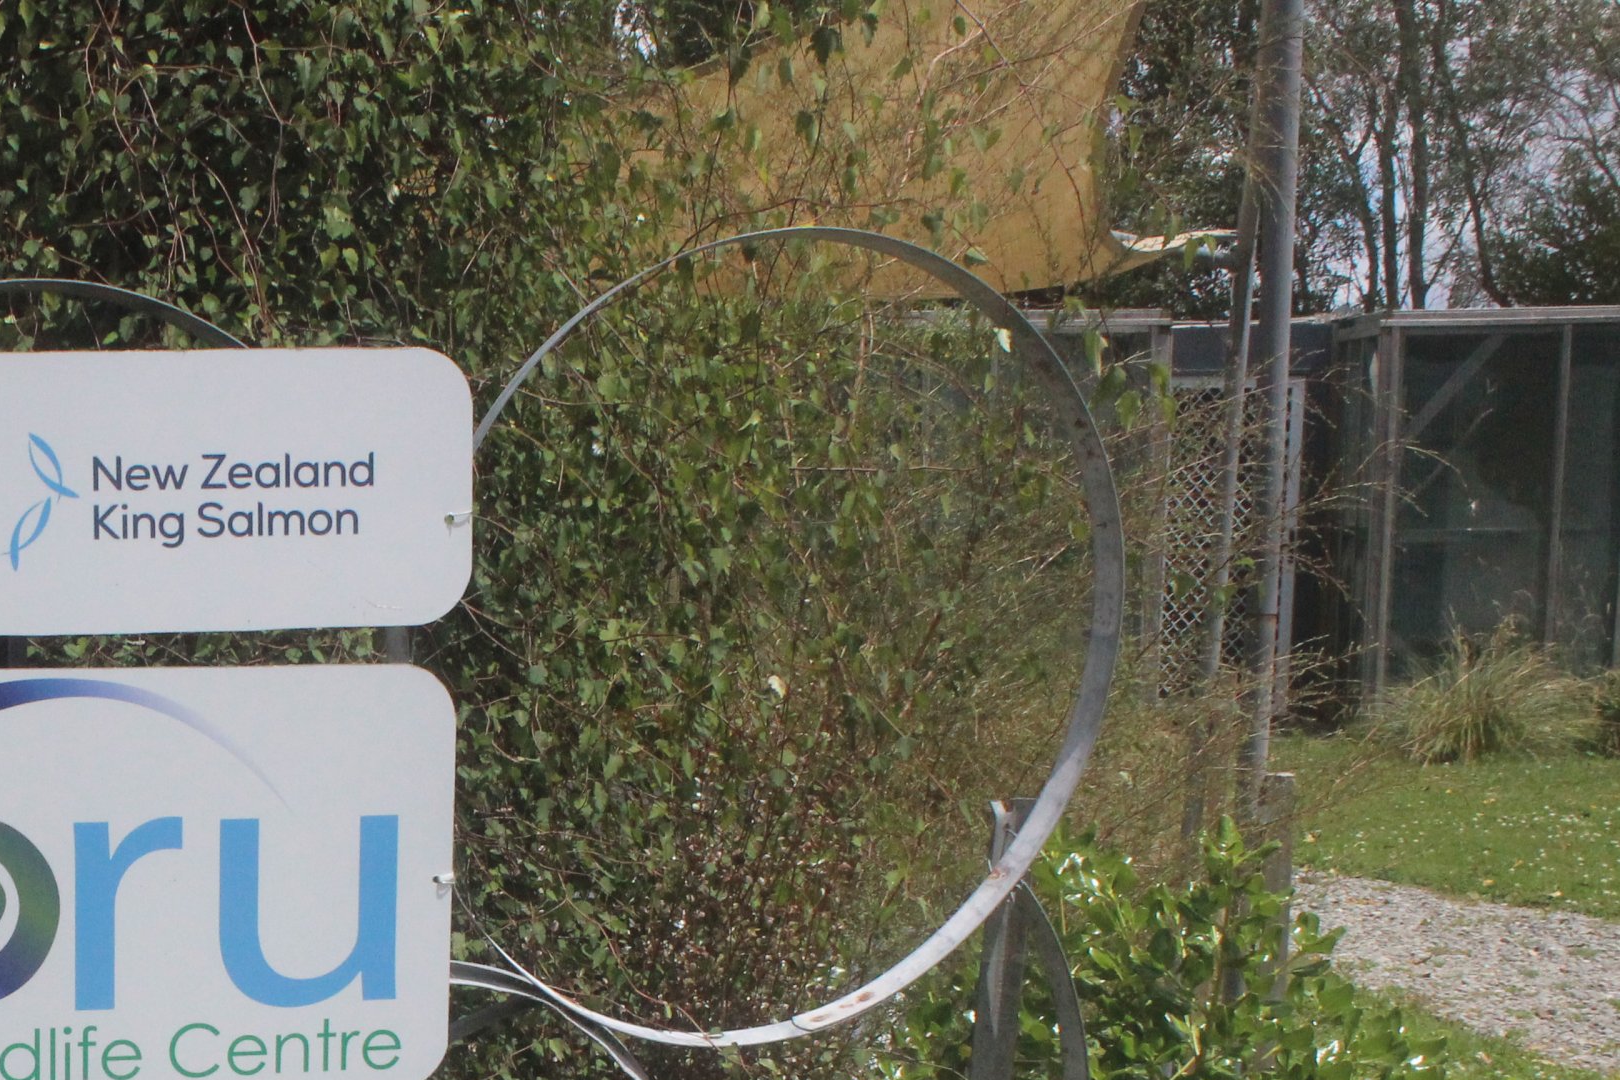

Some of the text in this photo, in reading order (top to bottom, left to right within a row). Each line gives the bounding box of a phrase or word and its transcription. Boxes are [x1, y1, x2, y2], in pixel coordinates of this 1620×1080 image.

[92, 451, 376, 492] New Zealand
[92, 502, 360, 549] King Salmon
[167, 1016, 403, 1080] Centre
